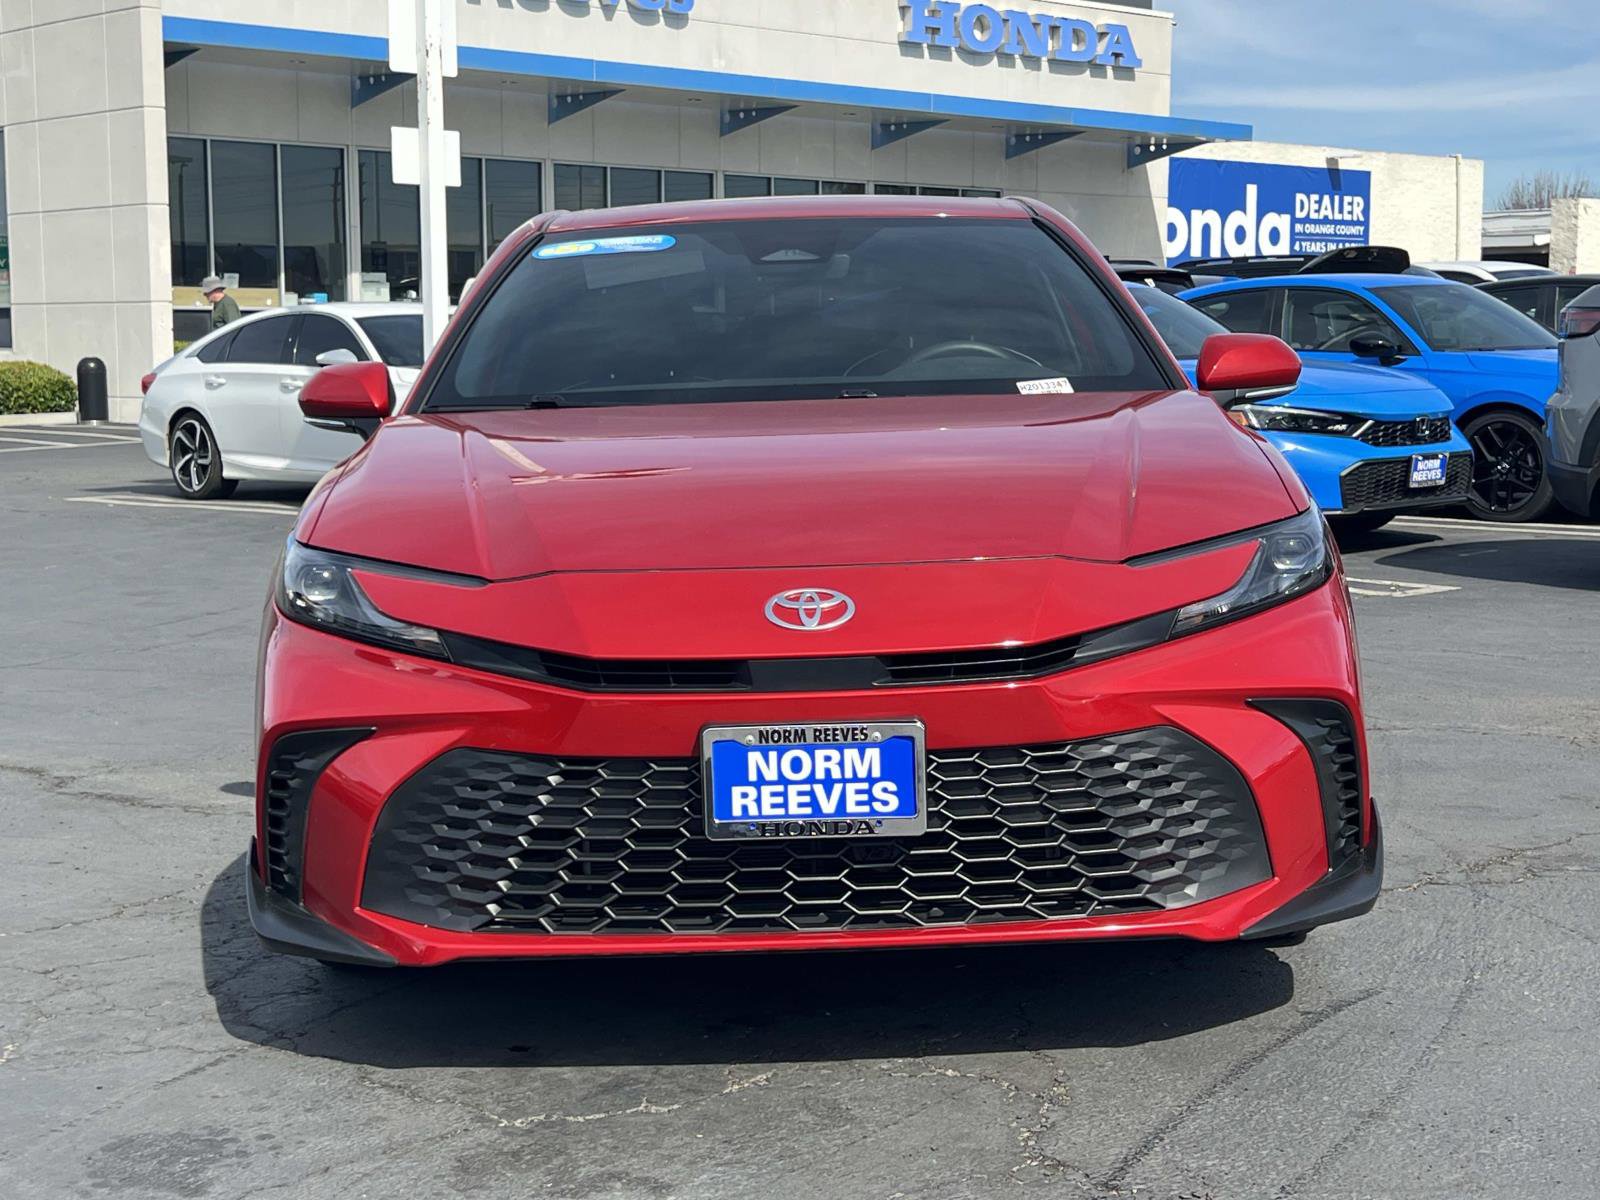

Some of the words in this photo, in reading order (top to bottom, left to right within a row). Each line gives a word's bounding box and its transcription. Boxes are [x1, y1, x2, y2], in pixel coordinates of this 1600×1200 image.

[901, 0, 1142, 68] HONDA
[1294, 192, 1365, 222] DEALER
[1294, 223, 1304, 233] IN
[1304, 224, 1335, 235] ORANGE
[1335, 225, 1365, 236] COUNTY
[1294, 241, 1301, 252] 4
[1301, 241, 1326, 253] YEARS
[1417, 459, 1440, 471] NORM
[1413, 470, 1441, 481] REEVES
[758, 728, 807, 744] NORM
[813, 727, 869, 743] REEVES
[747, 747, 882, 782] NORM
[730, 781, 900, 817] REEVES
[760, 820, 876, 837] HONDA
